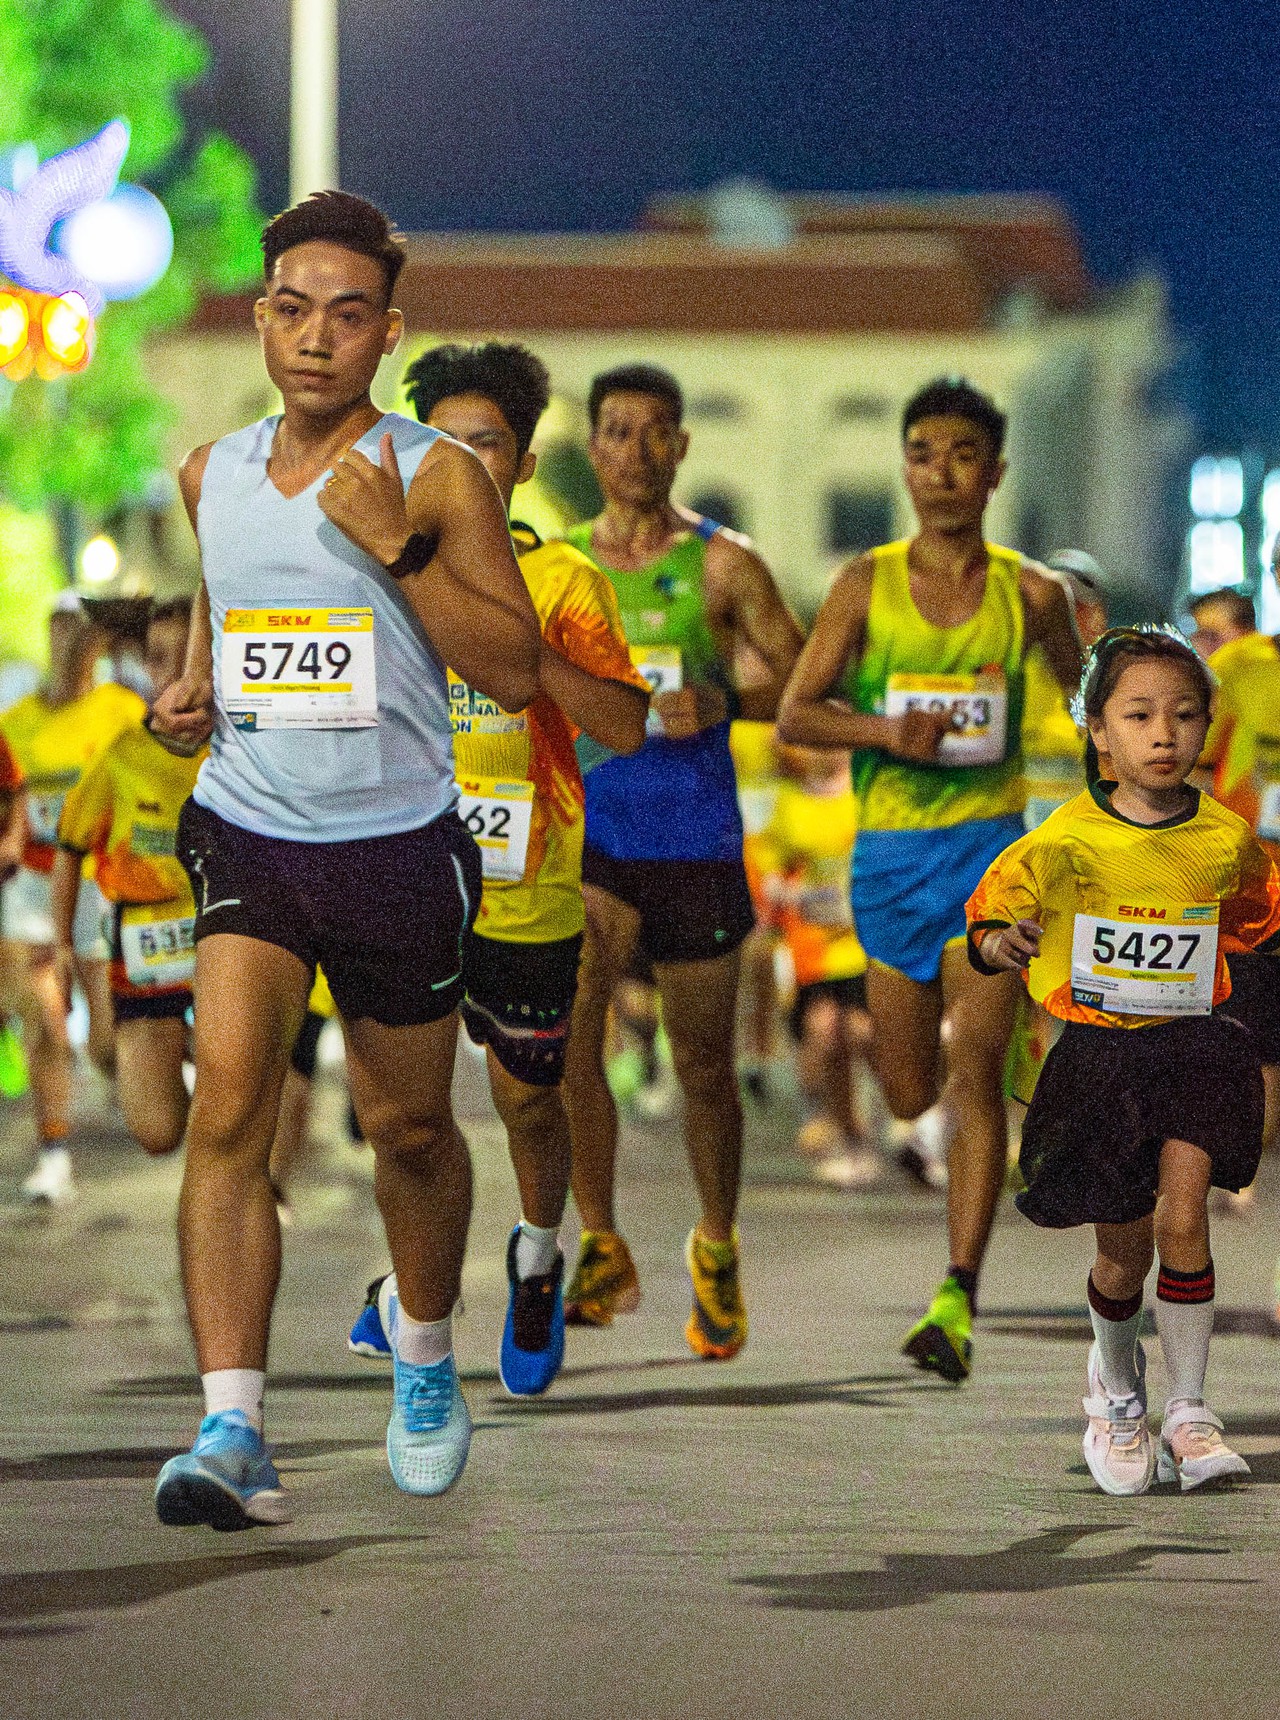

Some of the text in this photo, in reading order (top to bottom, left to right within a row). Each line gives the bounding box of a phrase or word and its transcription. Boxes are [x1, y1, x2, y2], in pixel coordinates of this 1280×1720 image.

[242, 641, 351, 681] 5749
[465, 804, 511, 838] 62
[1092, 926, 1201, 970] 5427
